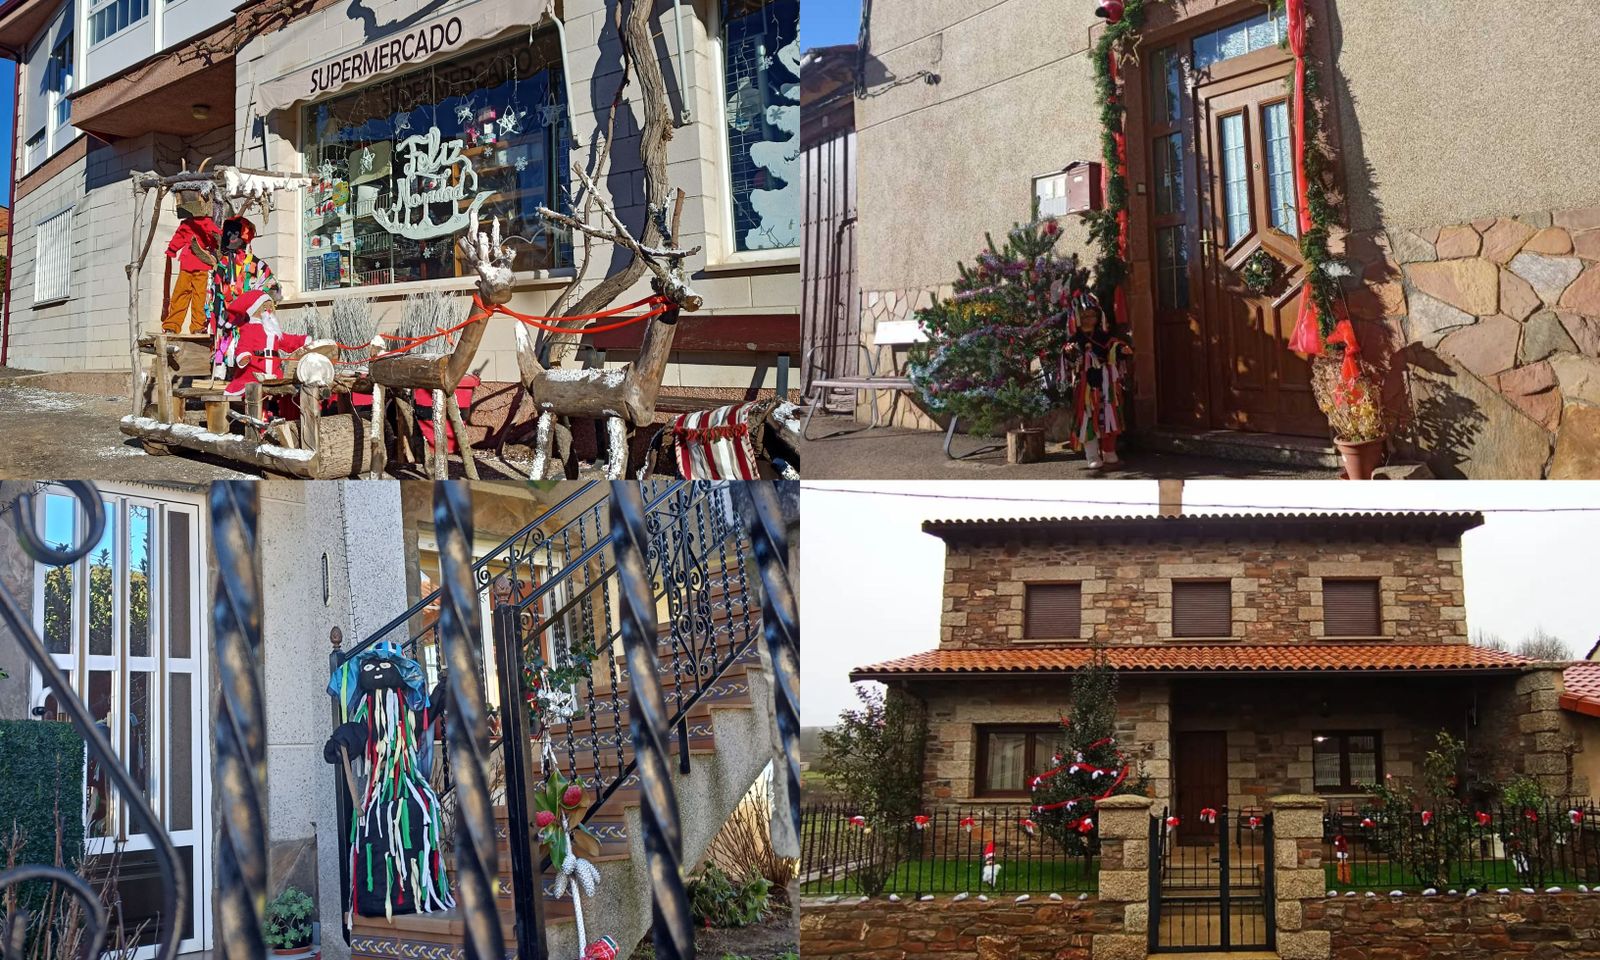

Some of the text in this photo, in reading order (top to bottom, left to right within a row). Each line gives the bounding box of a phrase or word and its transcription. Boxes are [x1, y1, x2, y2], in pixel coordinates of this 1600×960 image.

[310, 16, 462, 93] SUPERMERCADO
[396, 126, 463, 175] Feliz
[392, 166, 469, 212] Navidad
